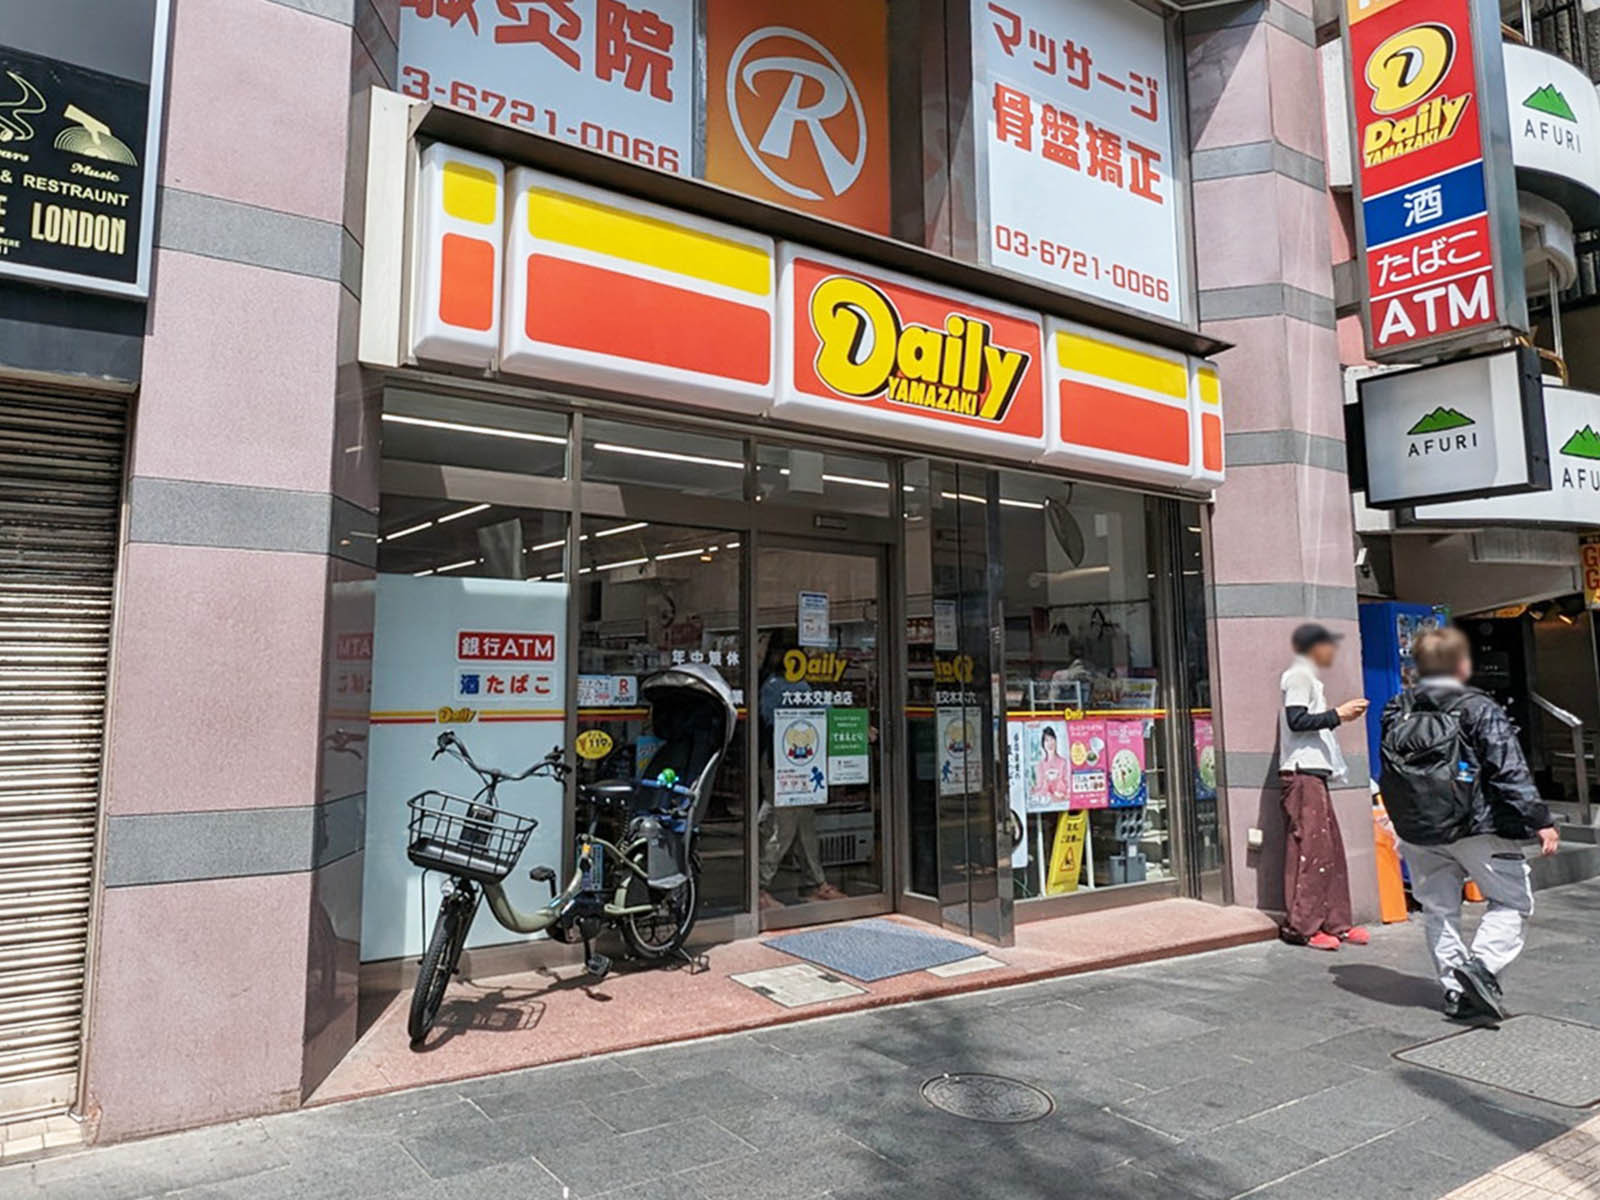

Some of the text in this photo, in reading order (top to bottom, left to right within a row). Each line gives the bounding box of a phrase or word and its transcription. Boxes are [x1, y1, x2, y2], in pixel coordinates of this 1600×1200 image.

[989, 2, 1159, 123] マッサージ
[993, 81, 1164, 205] 骨盤矯正
[1364, 95, 1468, 154] Daily
[1523, 119, 1581, 153] AFURI
[23, 174, 129, 207] RESTRAUNT
[70, 162, 120, 182] Music
[31, 202, 126, 255] LONDON
[1404, 184, 1442, 227] 酒
[995, 224, 1169, 303] 03-6721-0066
[1377, 230, 1482, 288] たばこ
[1378, 275, 1490, 344] ATM
[811, 276, 1030, 420] Daily
[888, 376, 978, 416] YAMAZAKI
[1408, 432, 1478, 457] AFURI
[461, 637, 552, 658] 銀行ATM
[784, 649, 848, 683] Daily
